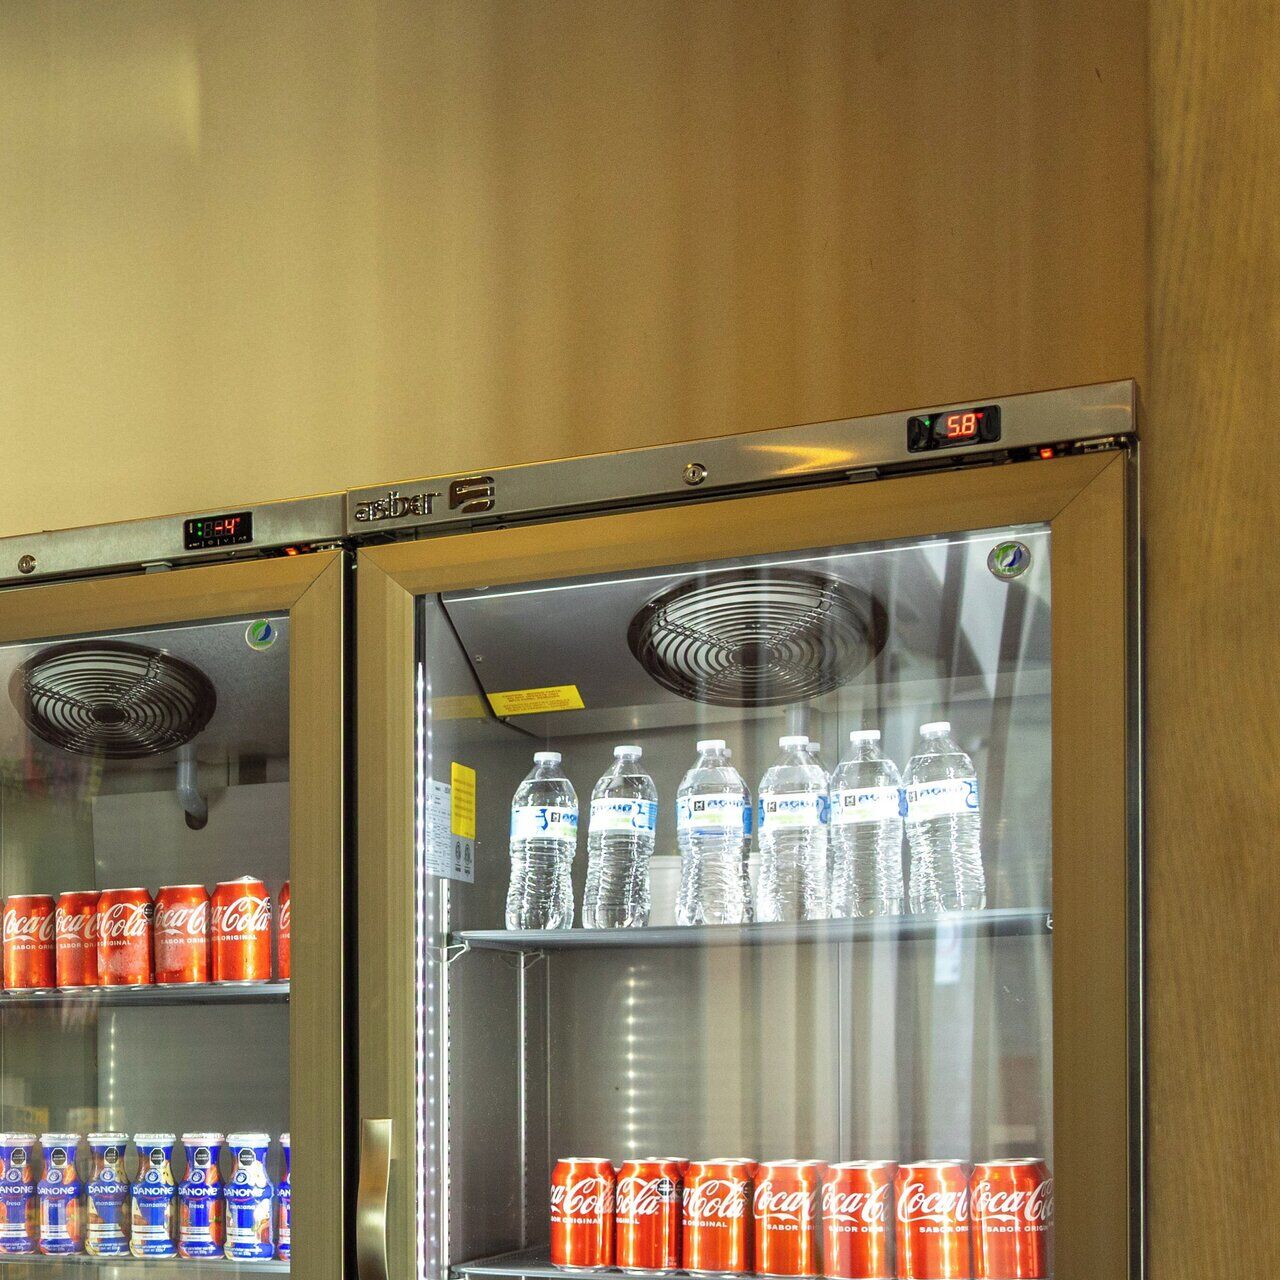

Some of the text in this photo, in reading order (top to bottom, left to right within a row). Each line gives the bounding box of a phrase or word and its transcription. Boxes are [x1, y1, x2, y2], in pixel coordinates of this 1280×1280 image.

[947, 413, 977, 439] 5.8
[88, 1185, 129, 1194] DANONE
[133, 1186, 175, 1195] DANONE
[178, 1187, 219, 1196] DANONE
